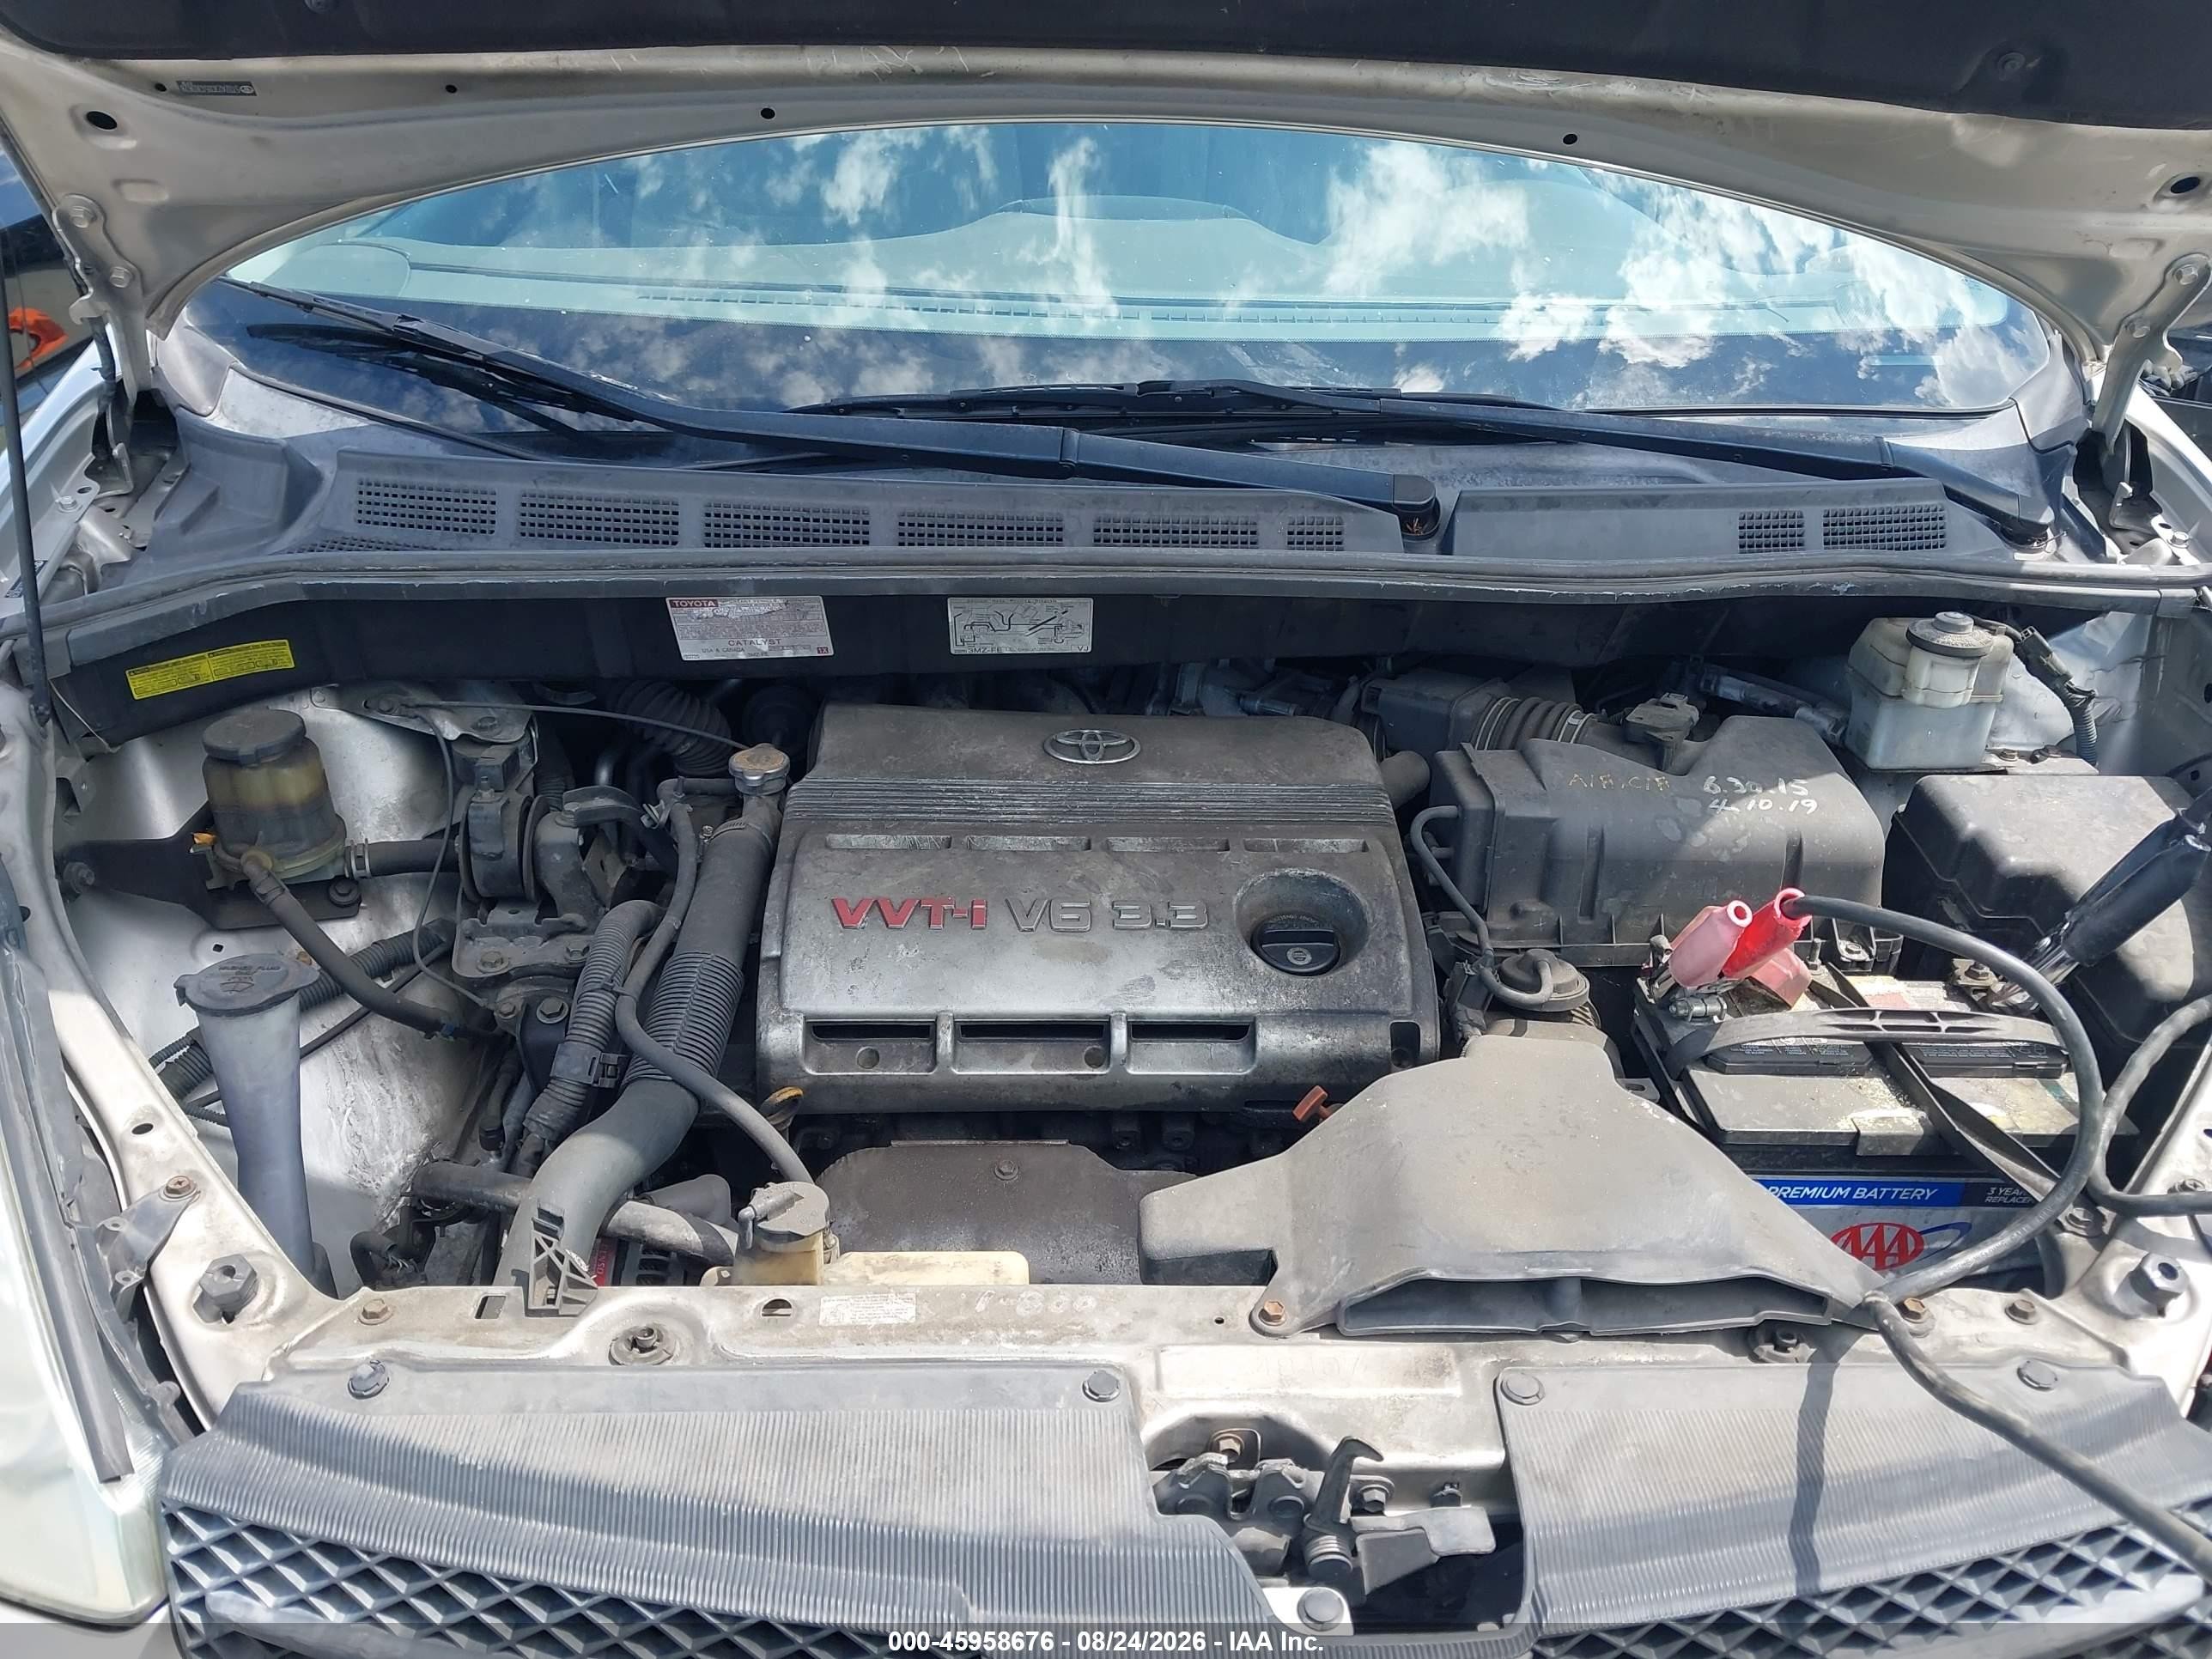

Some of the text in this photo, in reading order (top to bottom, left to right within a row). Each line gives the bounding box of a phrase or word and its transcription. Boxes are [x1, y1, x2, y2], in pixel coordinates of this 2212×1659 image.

[727, 638, 782, 647] CATALYST
[1005, 899, 1092, 933] V6
[1112, 900, 1209, 931] 3.3
[1767, 1186, 1937, 1200] PREMIUM BATTERY
[1987, 1187, 1996, 1195] 3
[1834, 1223, 1922, 1271] AAA
